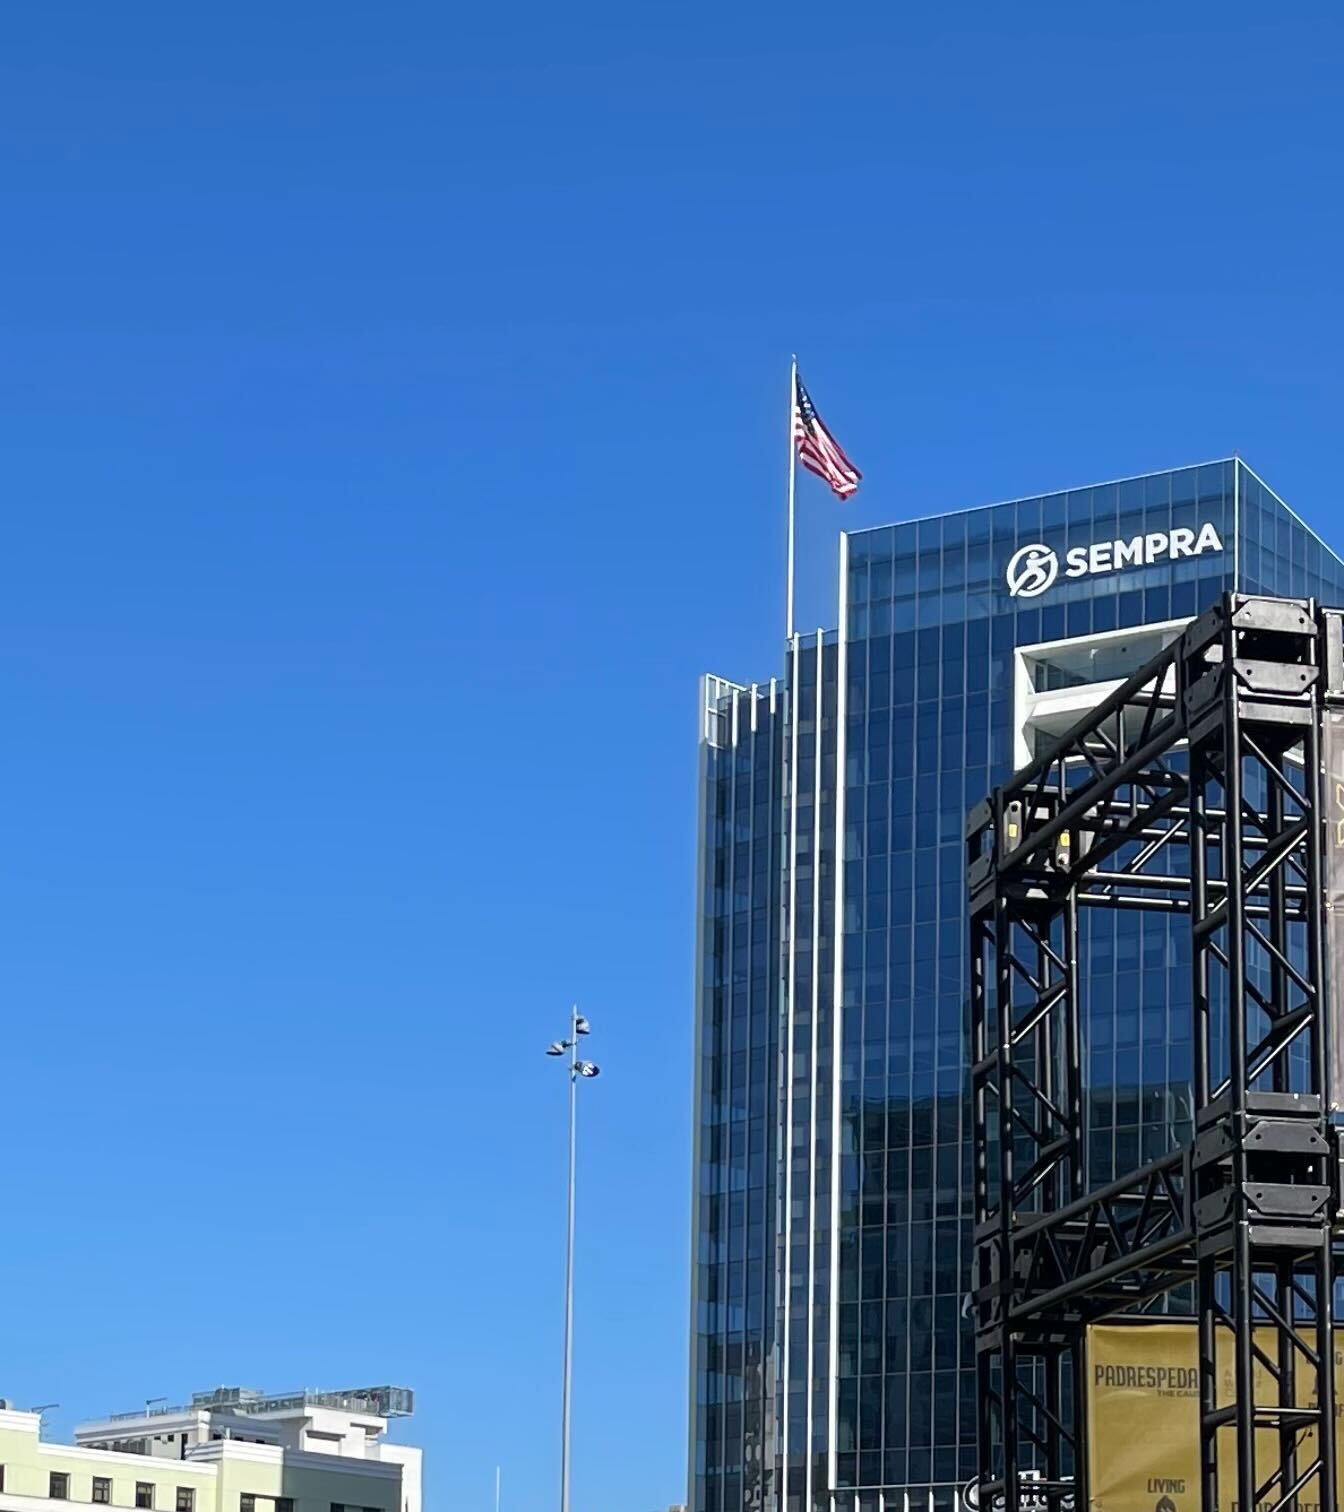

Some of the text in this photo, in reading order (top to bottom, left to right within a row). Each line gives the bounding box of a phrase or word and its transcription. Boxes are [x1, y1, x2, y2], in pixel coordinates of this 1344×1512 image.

[1065, 523, 1223, 577] SEMPRA
[1094, 1364, 1200, 1388] PADRESPEDA
[1147, 1478, 1185, 1493] LIVING
